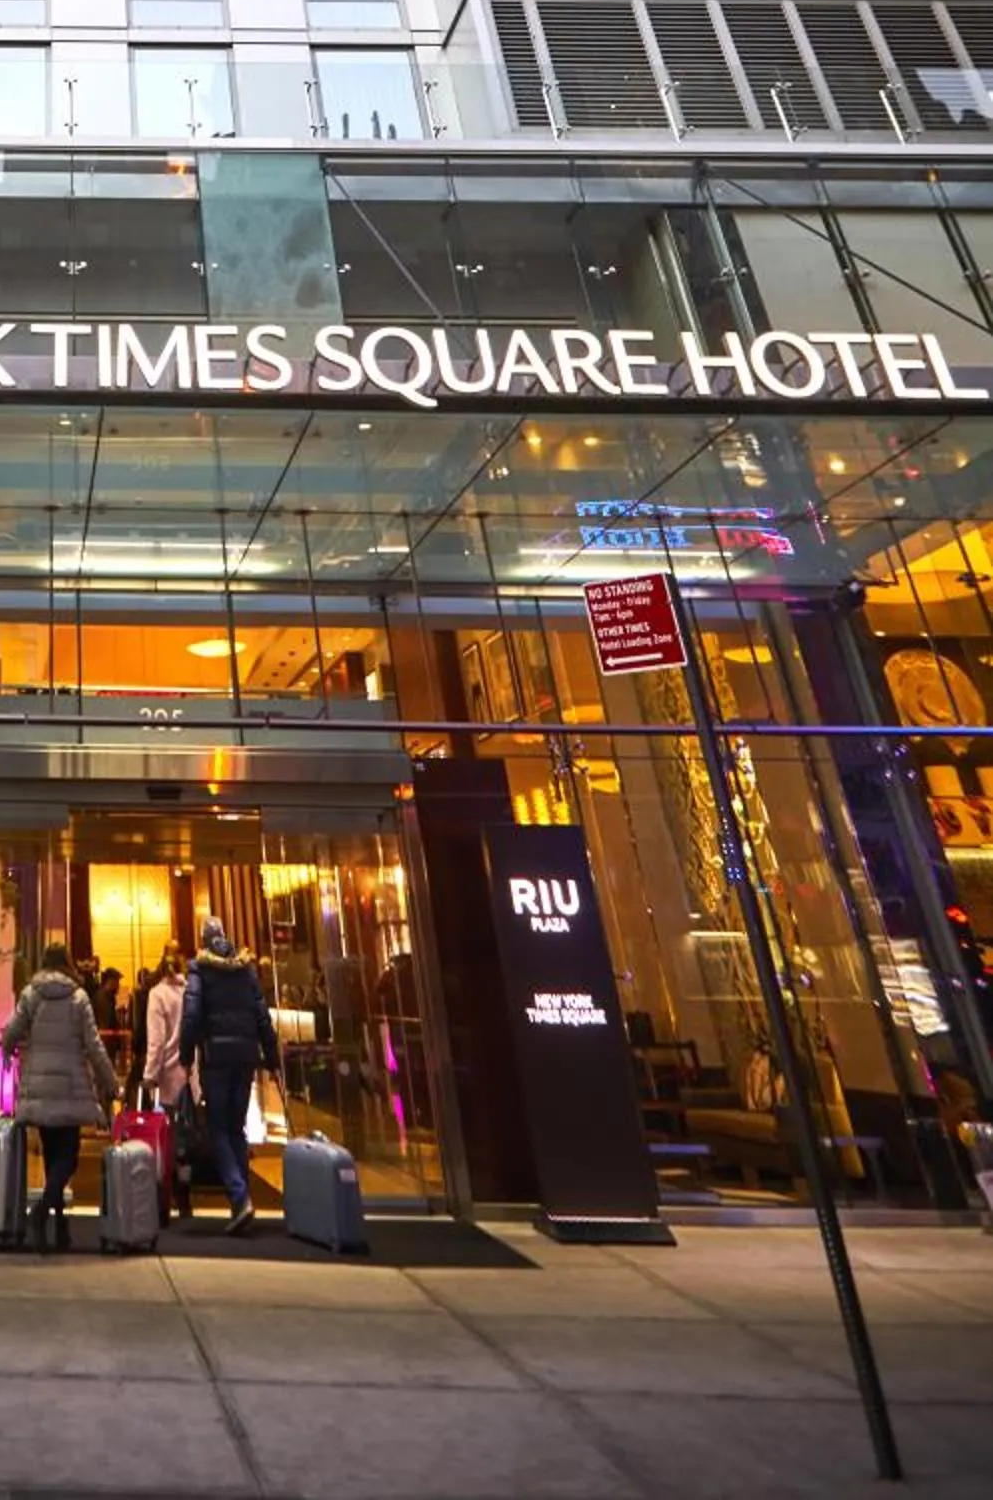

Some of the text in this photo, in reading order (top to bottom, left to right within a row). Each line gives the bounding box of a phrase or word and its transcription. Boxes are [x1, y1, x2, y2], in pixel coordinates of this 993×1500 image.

[30, 322, 293, 391] TIMES
[314, 325, 668, 407] SQUARE
[681, 329, 990, 400] HOTEL
[588, 580, 654, 600] NO STANDING
[597, 621, 651, 638] OTHER TIMES
[509, 878, 580, 916] RIU
[530, 916, 570, 933] PLAZA
[534, 993, 593, 1008] NEW YORK
[525, 1007, 608, 1027] TIMES SQUARE
